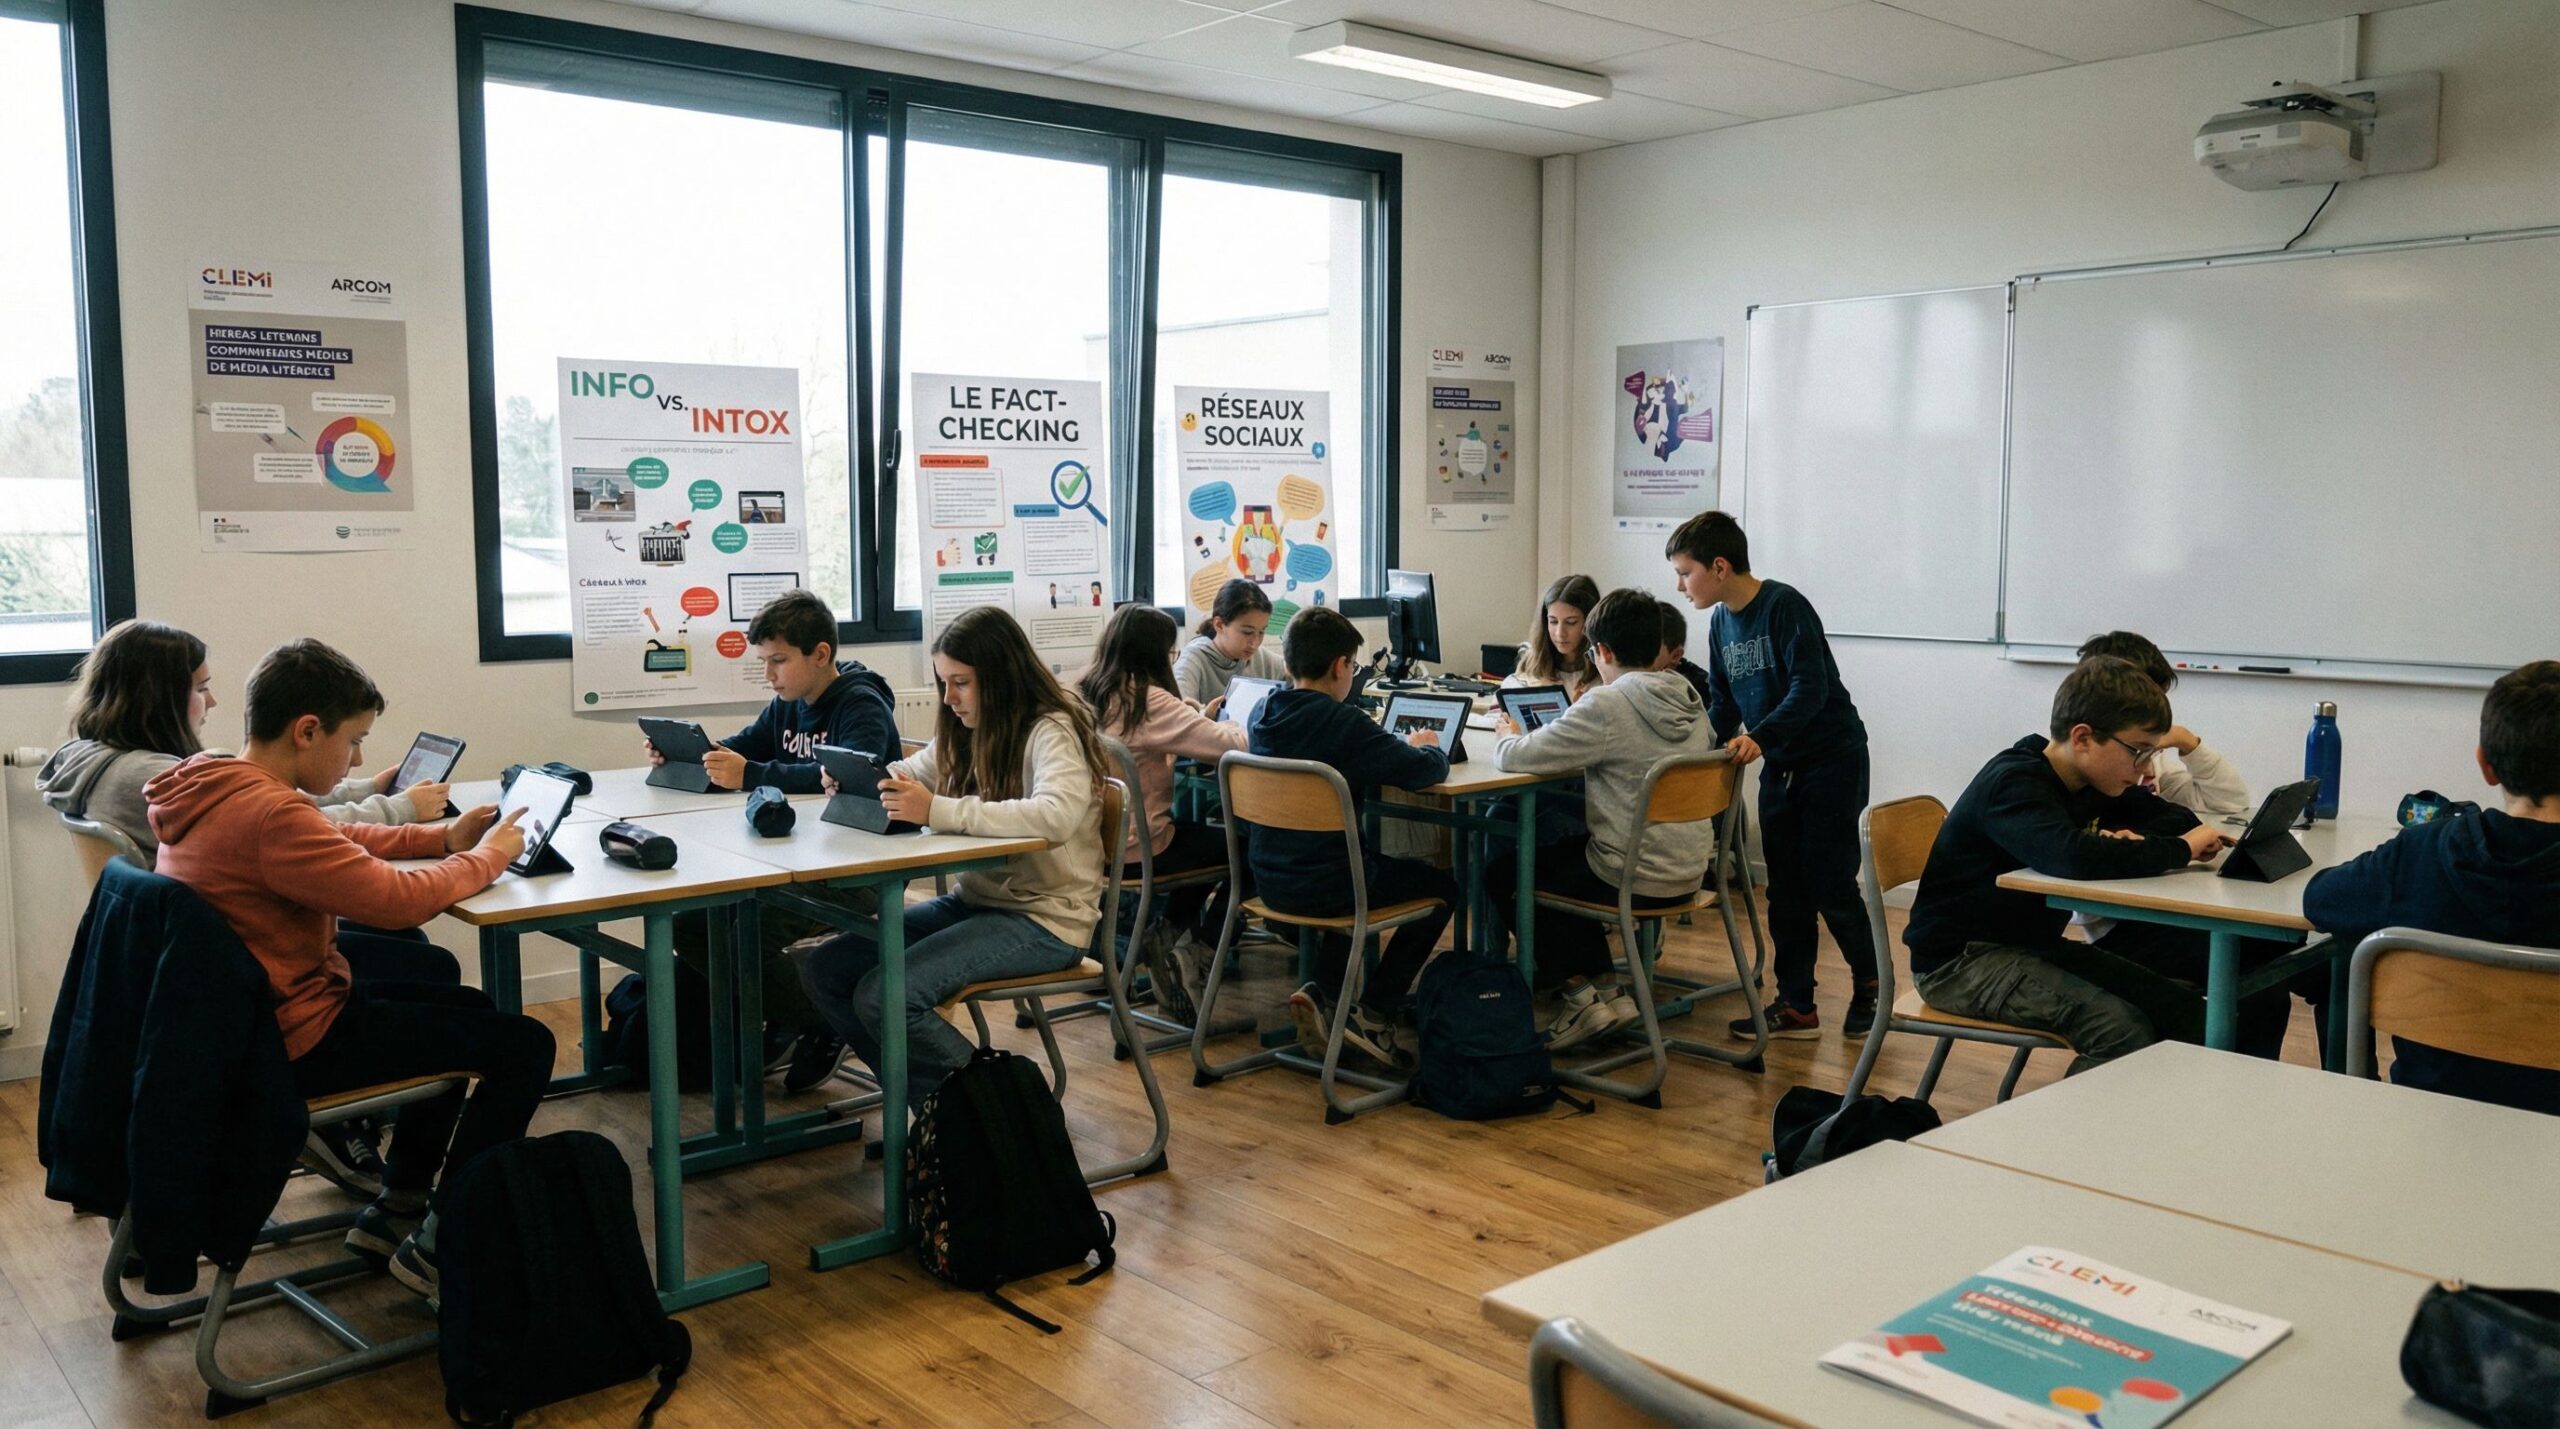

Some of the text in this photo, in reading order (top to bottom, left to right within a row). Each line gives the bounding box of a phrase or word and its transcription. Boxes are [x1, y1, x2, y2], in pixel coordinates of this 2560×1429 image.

[331, 278, 391, 294] ARCOM
[210, 362, 227, 372] DE
[570, 370, 655, 399] INFO
[691, 407, 791, 435] INTOX
[950, 386, 1067, 412] LE FACT-
[1201, 392, 1305, 421] RÉSEAUX
[939, 416, 1079, 442] CHECKING
[1204, 425, 1304, 447] SOCIAUX
[2027, 1255, 2138, 1297] CLEMI
